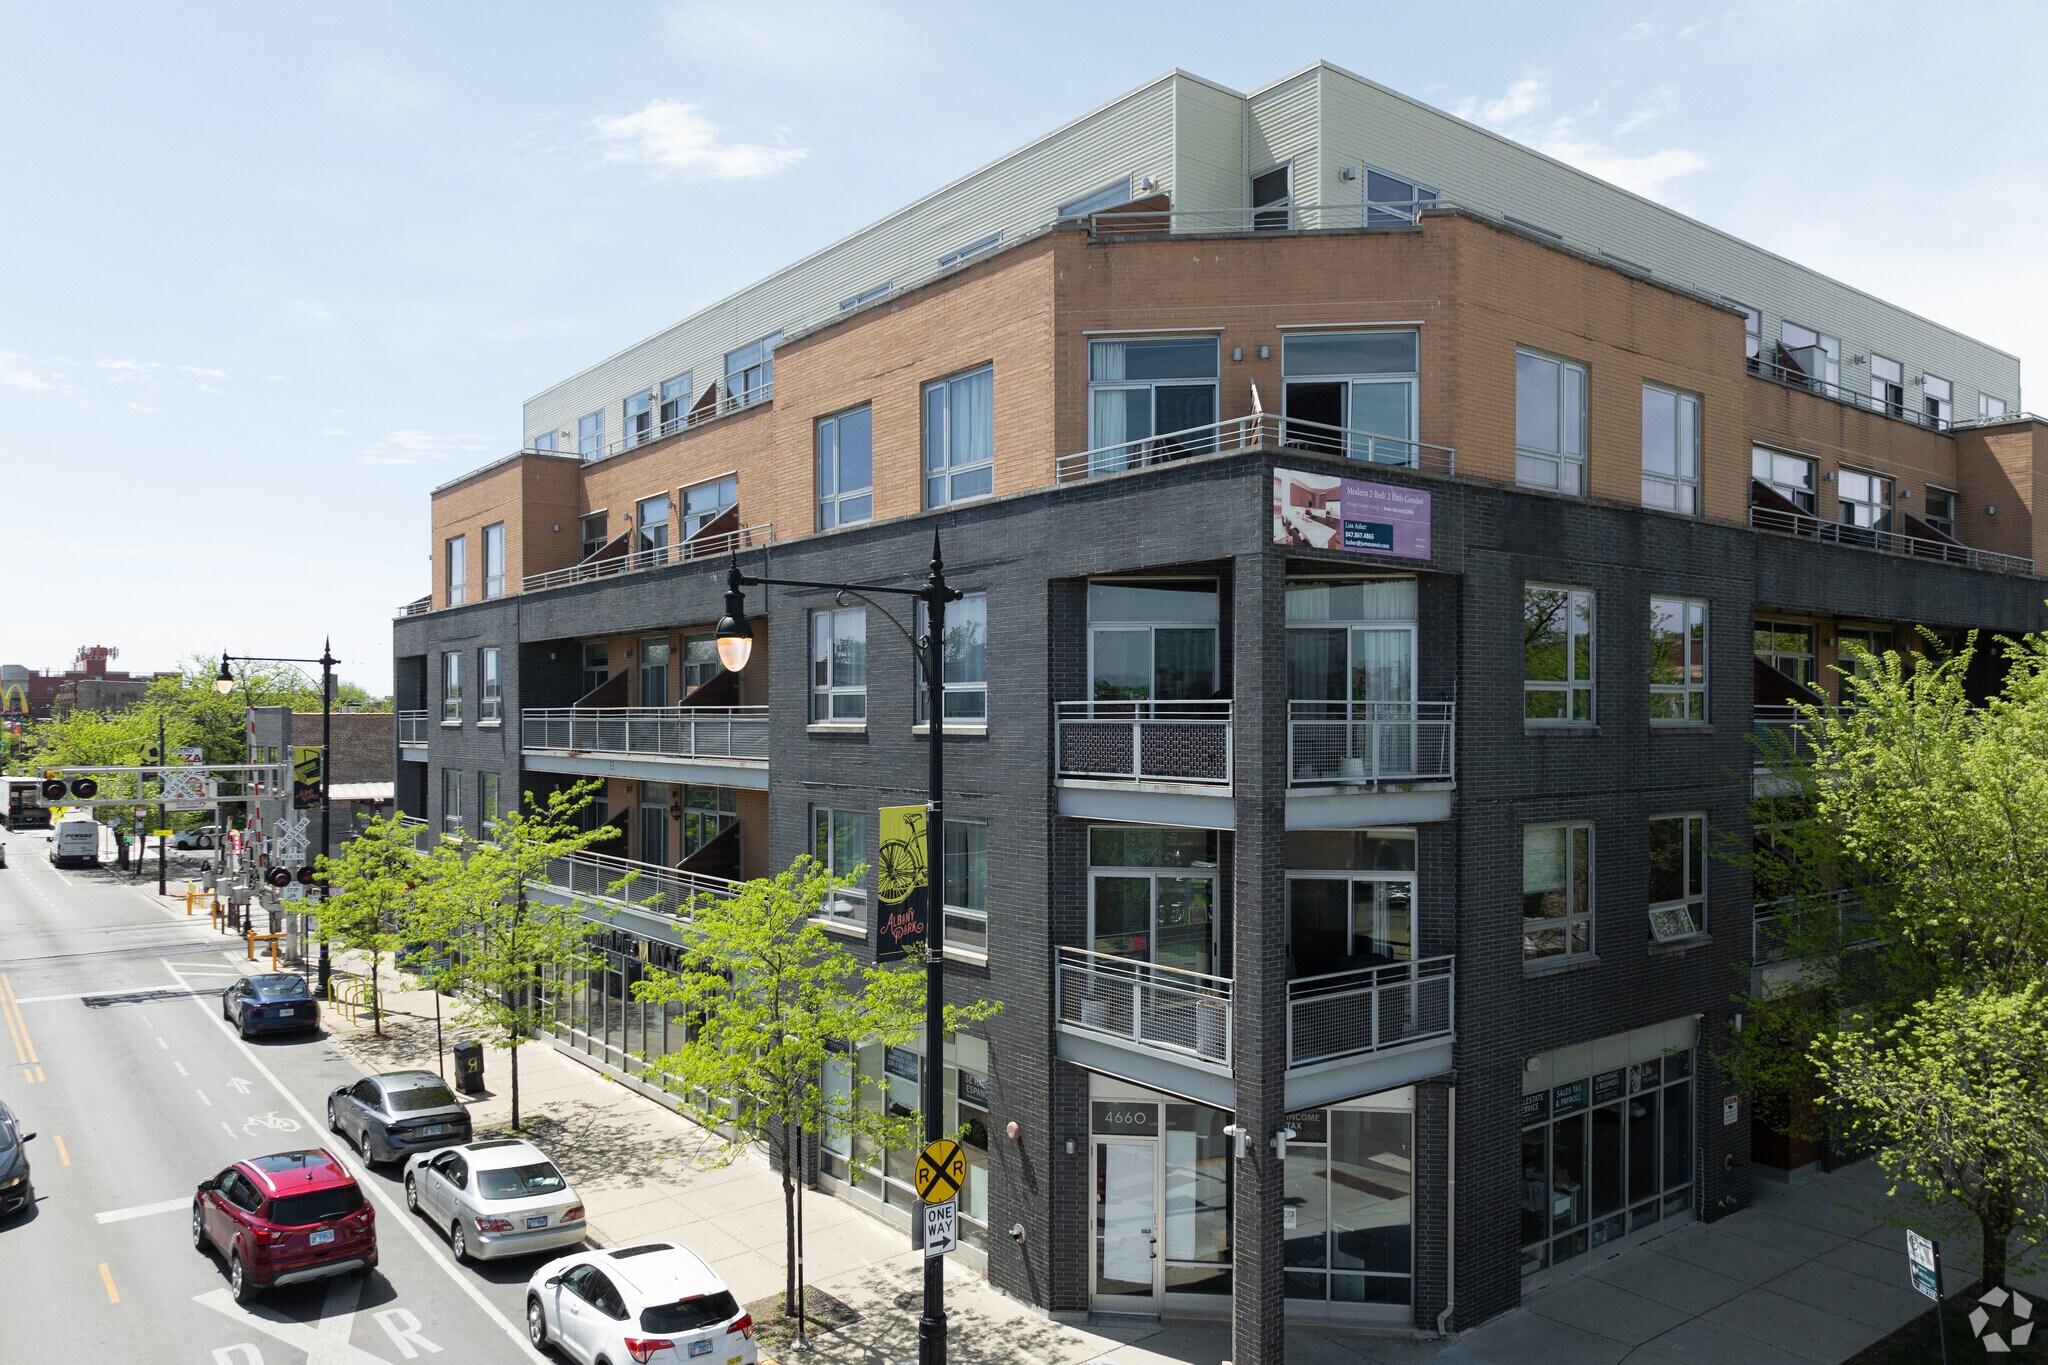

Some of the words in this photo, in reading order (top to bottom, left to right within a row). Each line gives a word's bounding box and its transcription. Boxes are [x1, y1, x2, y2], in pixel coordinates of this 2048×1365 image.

[1347, 486, 1369, 498] Modern
[1391, 493, 1404, 503] Bath
[1404, 494, 1425, 505] Condos
[1556, 1086, 1572, 1098] SALES
[1561, 1093, 1582, 1106] PAYROLL
[1105, 1111, 1147, 1125] 4660
[1285, 1121, 1302, 1130] TAX
[1296, 1131, 1321, 1139] RVICE
[919, 1168, 929, 1184] R
[953, 1160, 963, 1176] R
[928, 1207, 953, 1222] ONE
[928, 1220, 953, 1237] WAY
